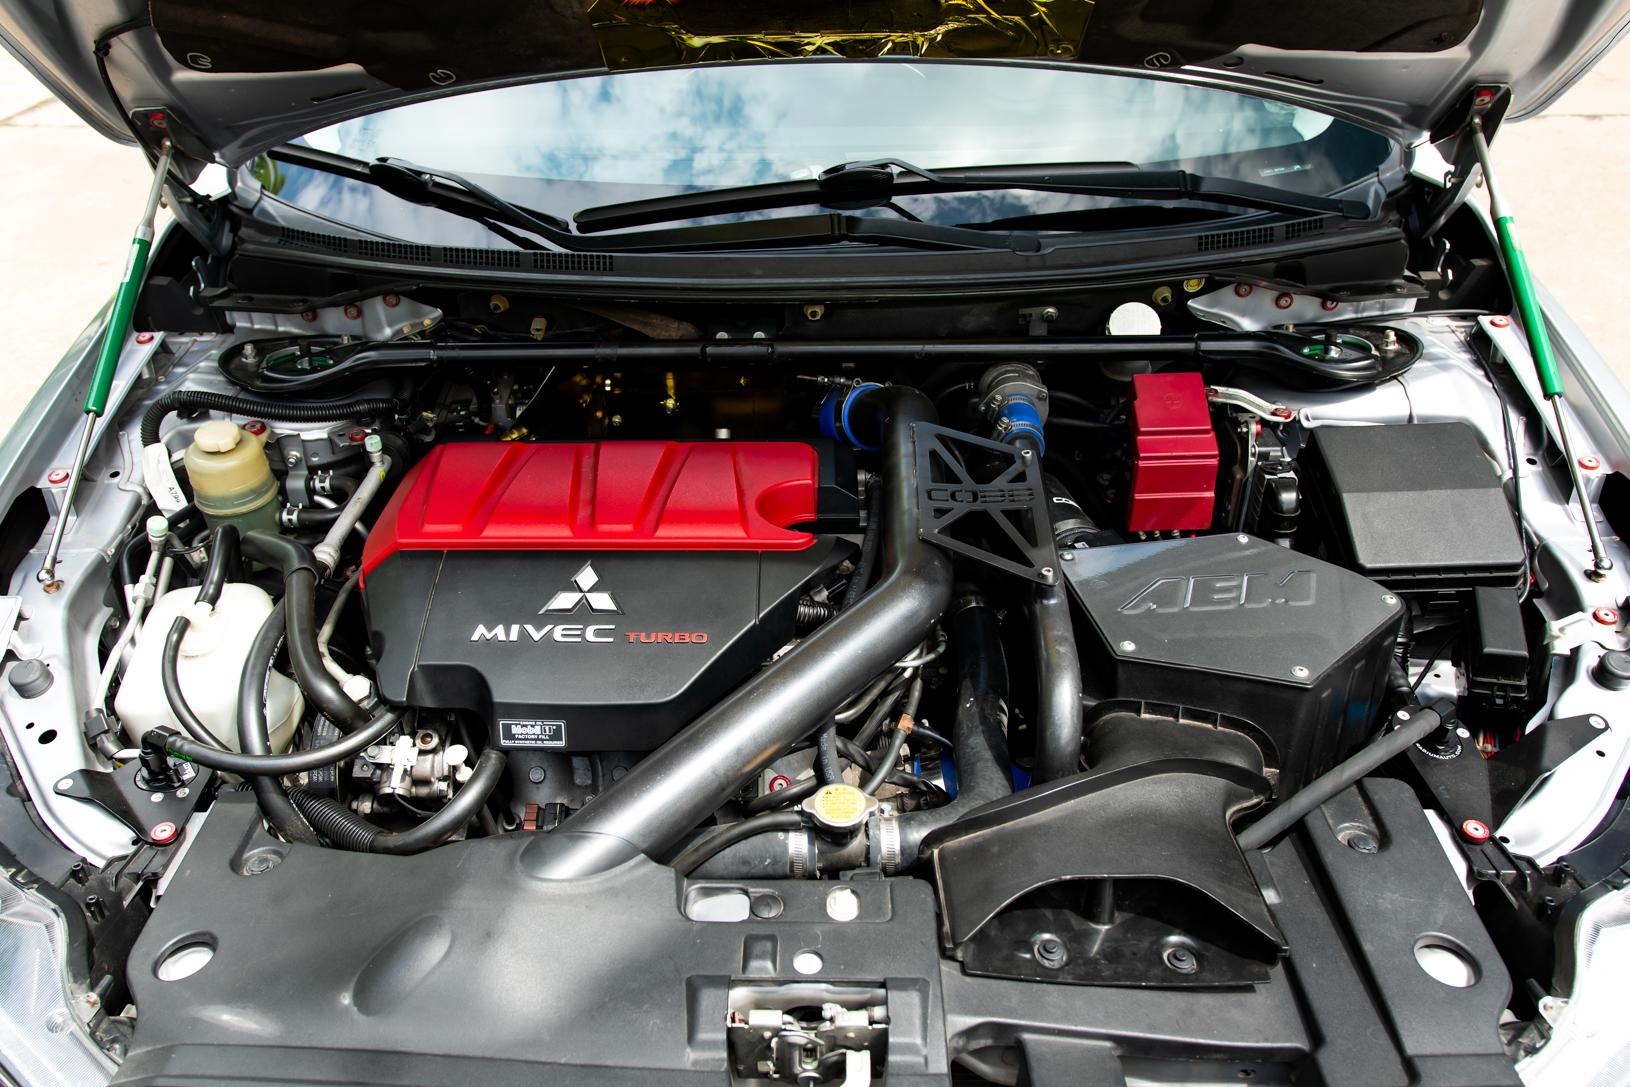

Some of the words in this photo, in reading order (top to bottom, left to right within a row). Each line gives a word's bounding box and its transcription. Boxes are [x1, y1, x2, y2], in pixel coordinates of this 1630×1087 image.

[927, 487, 1035, 503] COBB
[1118, 570, 1317, 614] AEM
[469, 623, 616, 643] MIVEC
[624, 631, 709, 644] TURBO
[511, 725, 541, 734] Mobil
